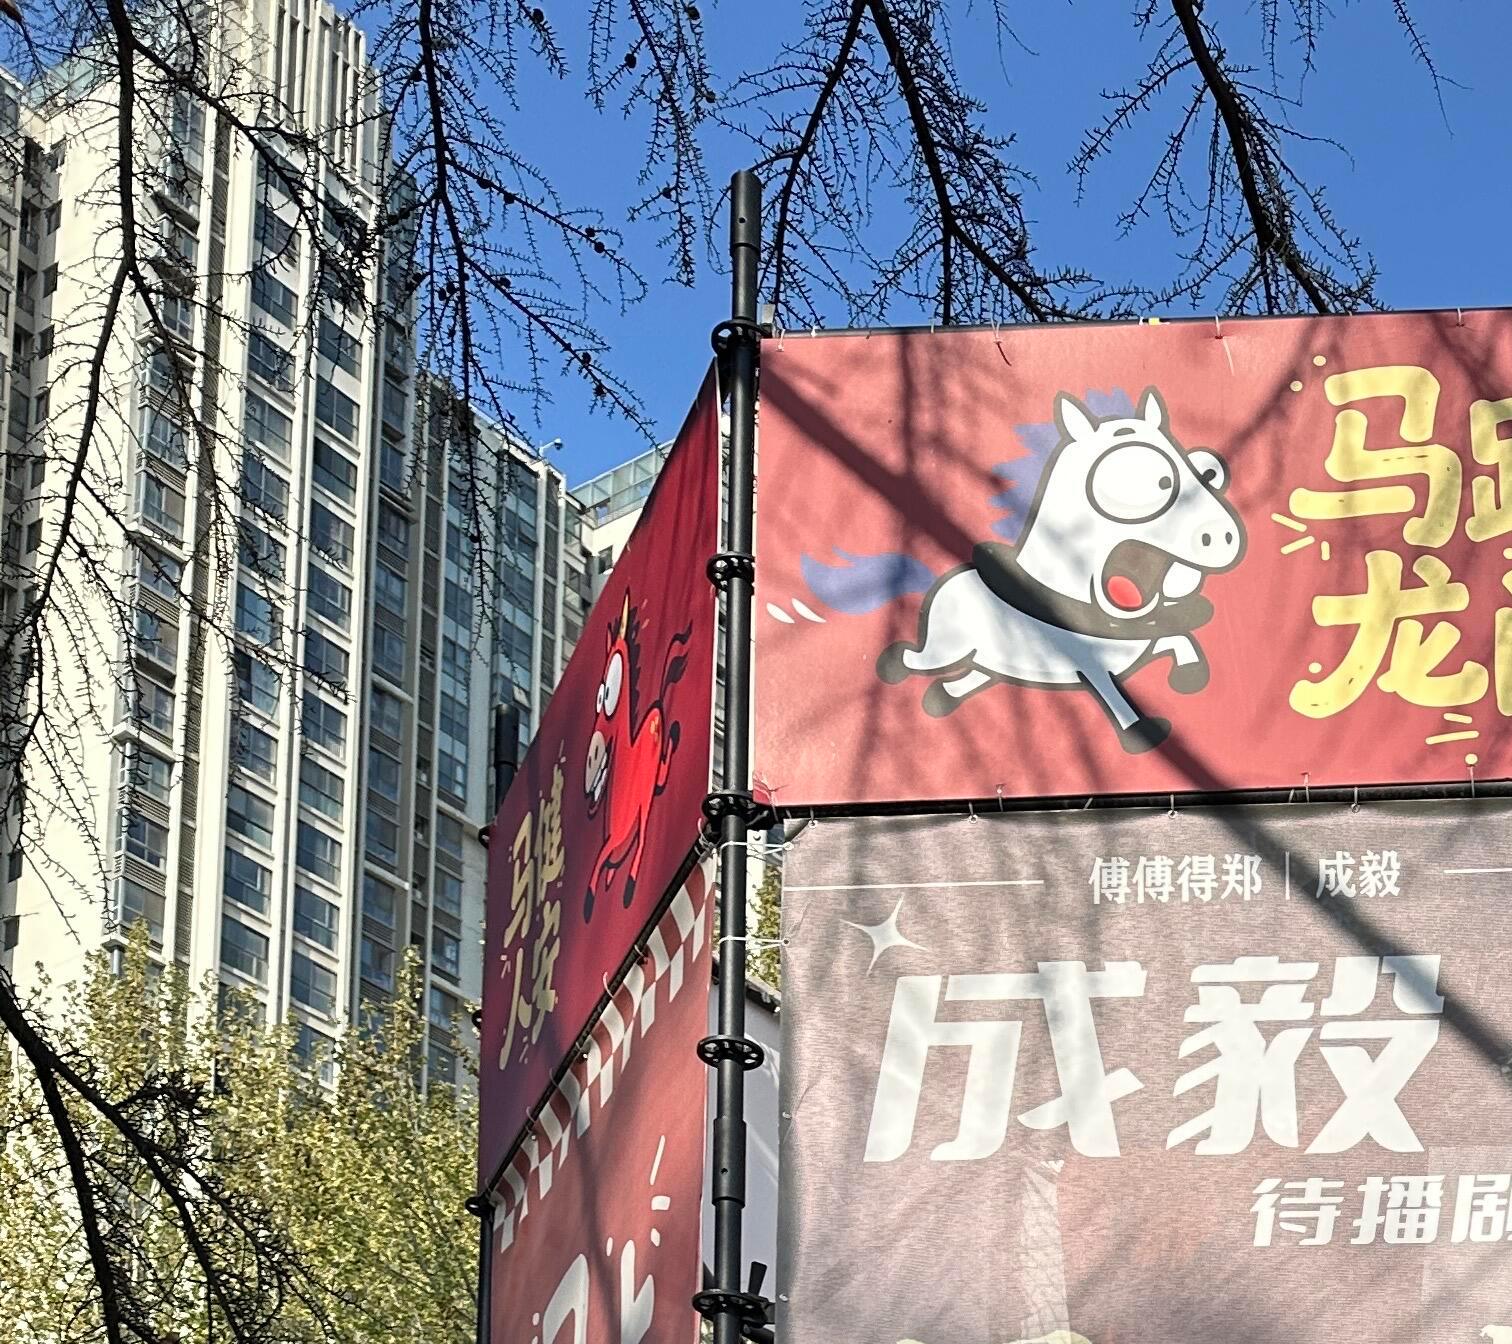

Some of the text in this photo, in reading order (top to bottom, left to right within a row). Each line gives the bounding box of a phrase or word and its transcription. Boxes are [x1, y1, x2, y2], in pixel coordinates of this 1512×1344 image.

[1088, 849, 1402, 905] 傅傅得郑 成毅
[863, 953, 1445, 1163] 成毅
